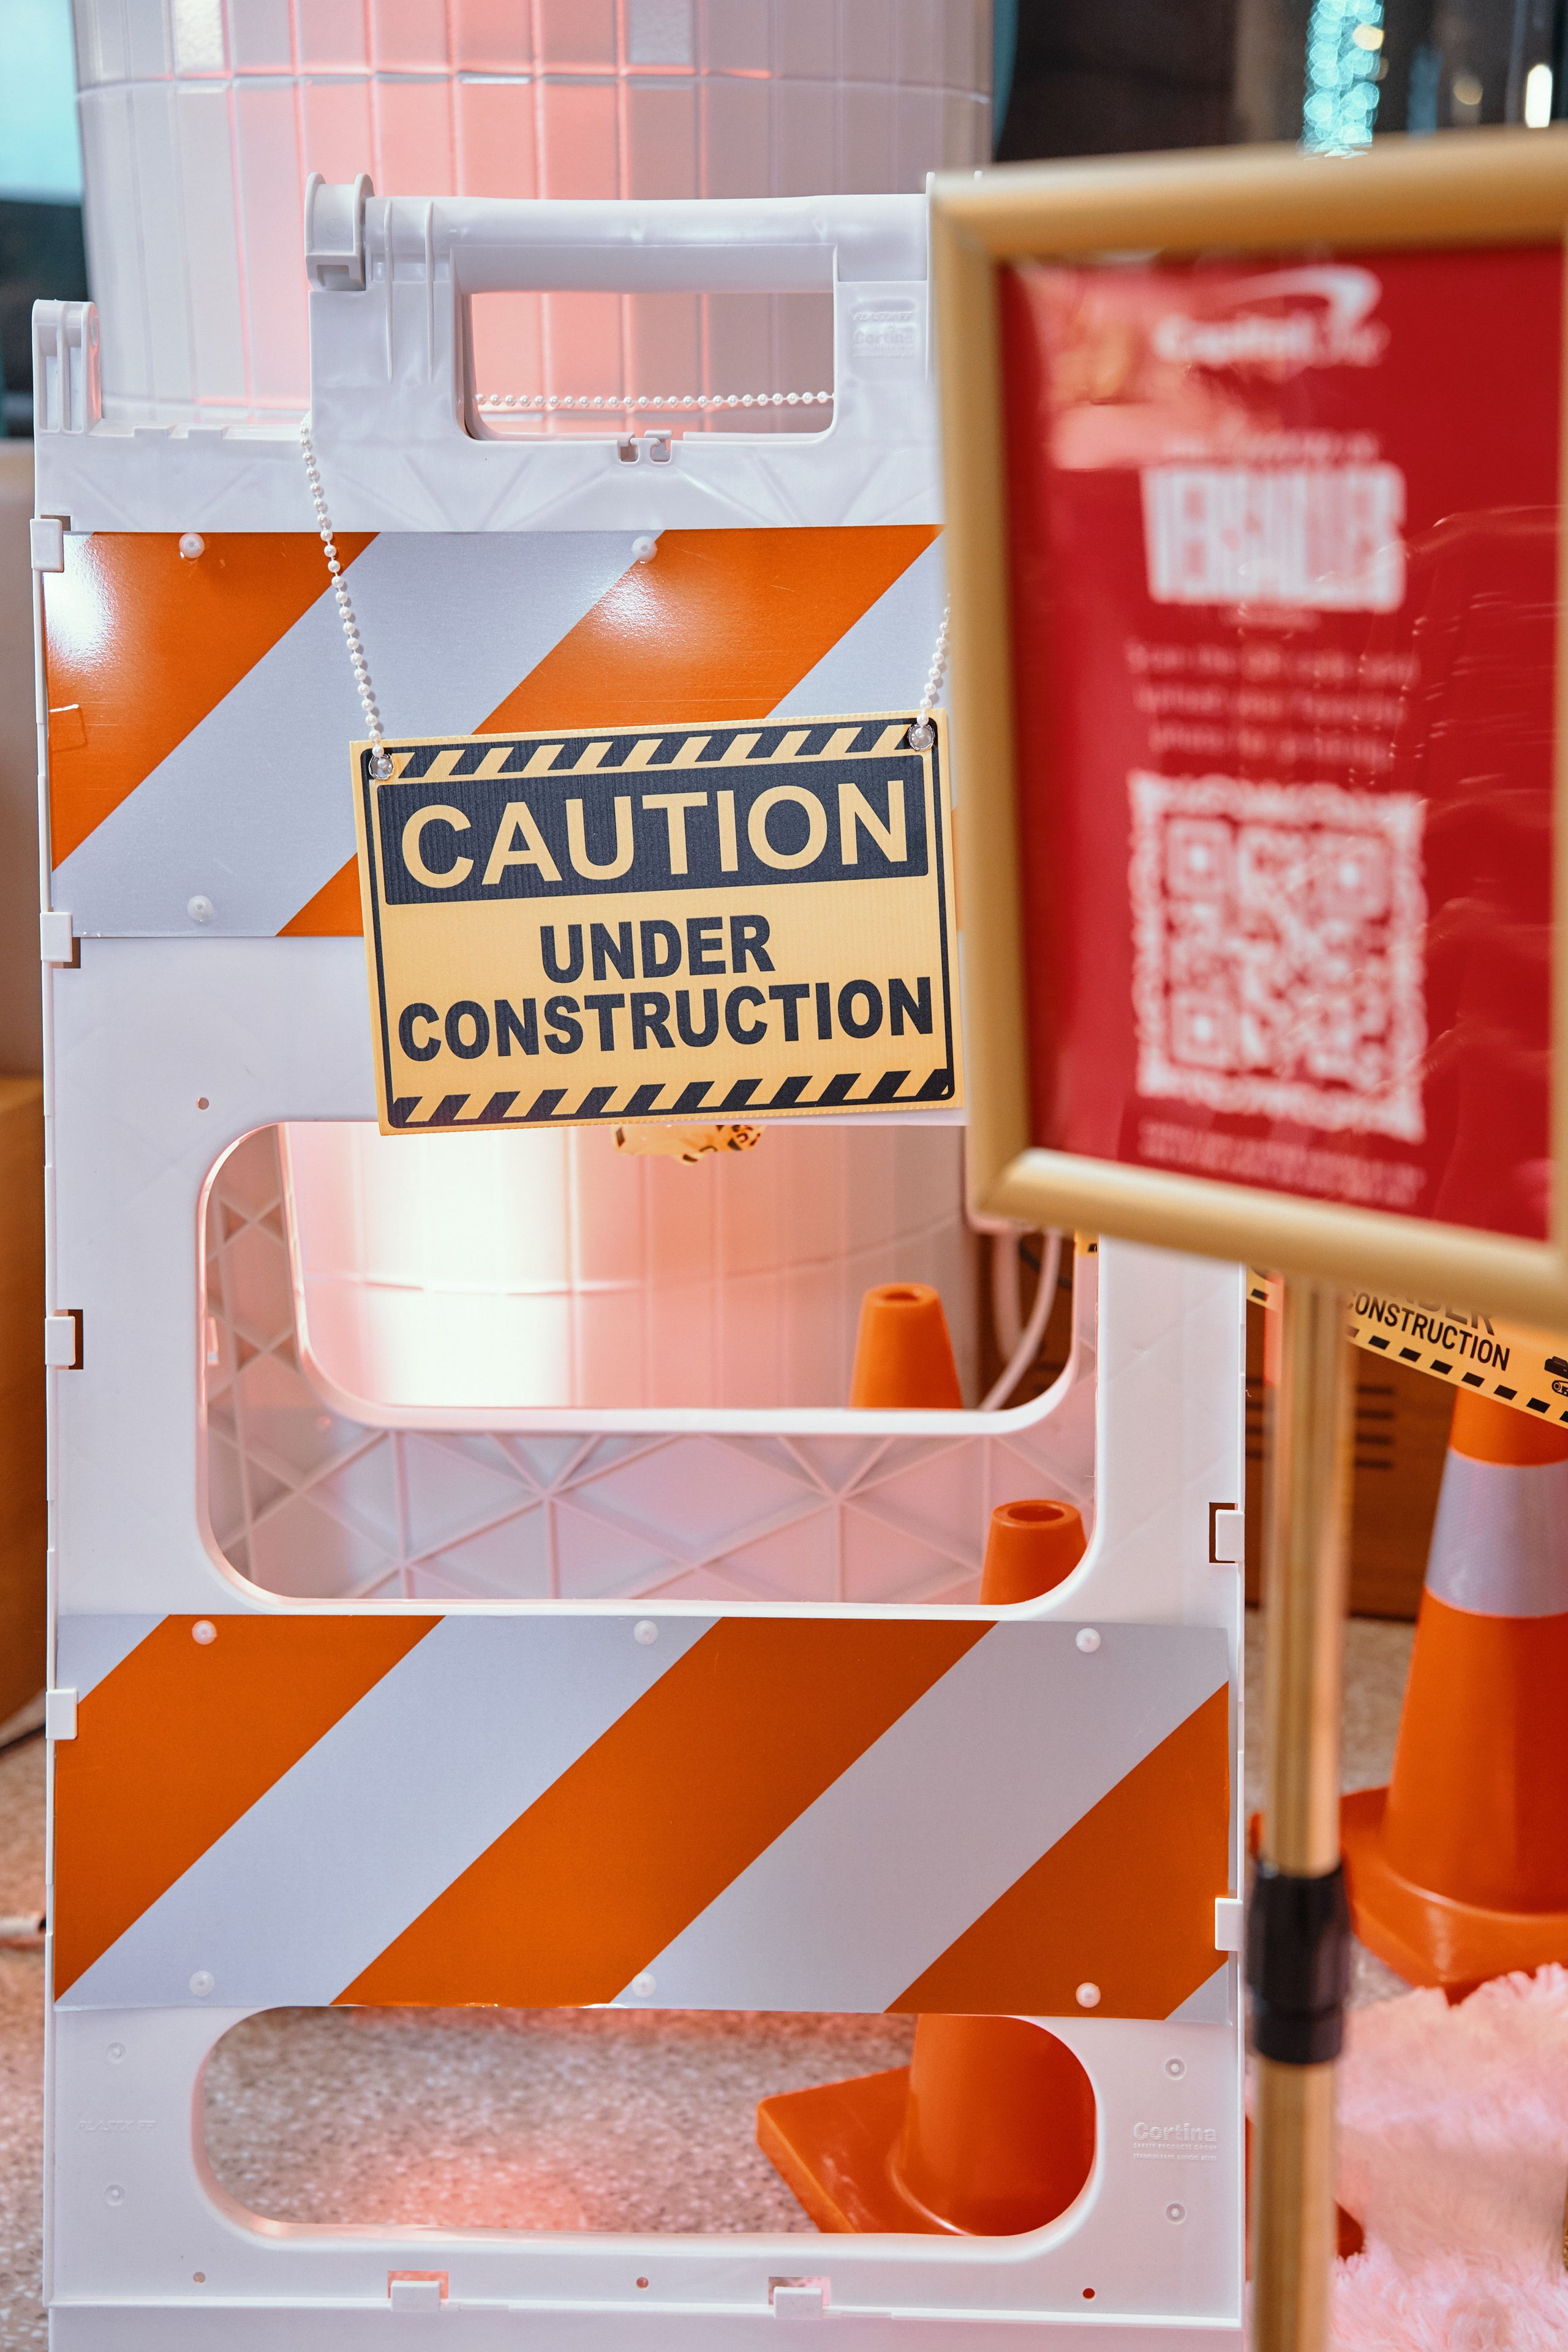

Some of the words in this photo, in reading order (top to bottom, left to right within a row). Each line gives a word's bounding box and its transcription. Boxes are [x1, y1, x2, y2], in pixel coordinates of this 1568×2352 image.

[401, 780, 909, 889] CAUTION
[539, 914, 775, 984] UNDER
[398, 976, 933, 1061] CONSTRUCTION
[1133, 2122, 1217, 2142] Cortina
